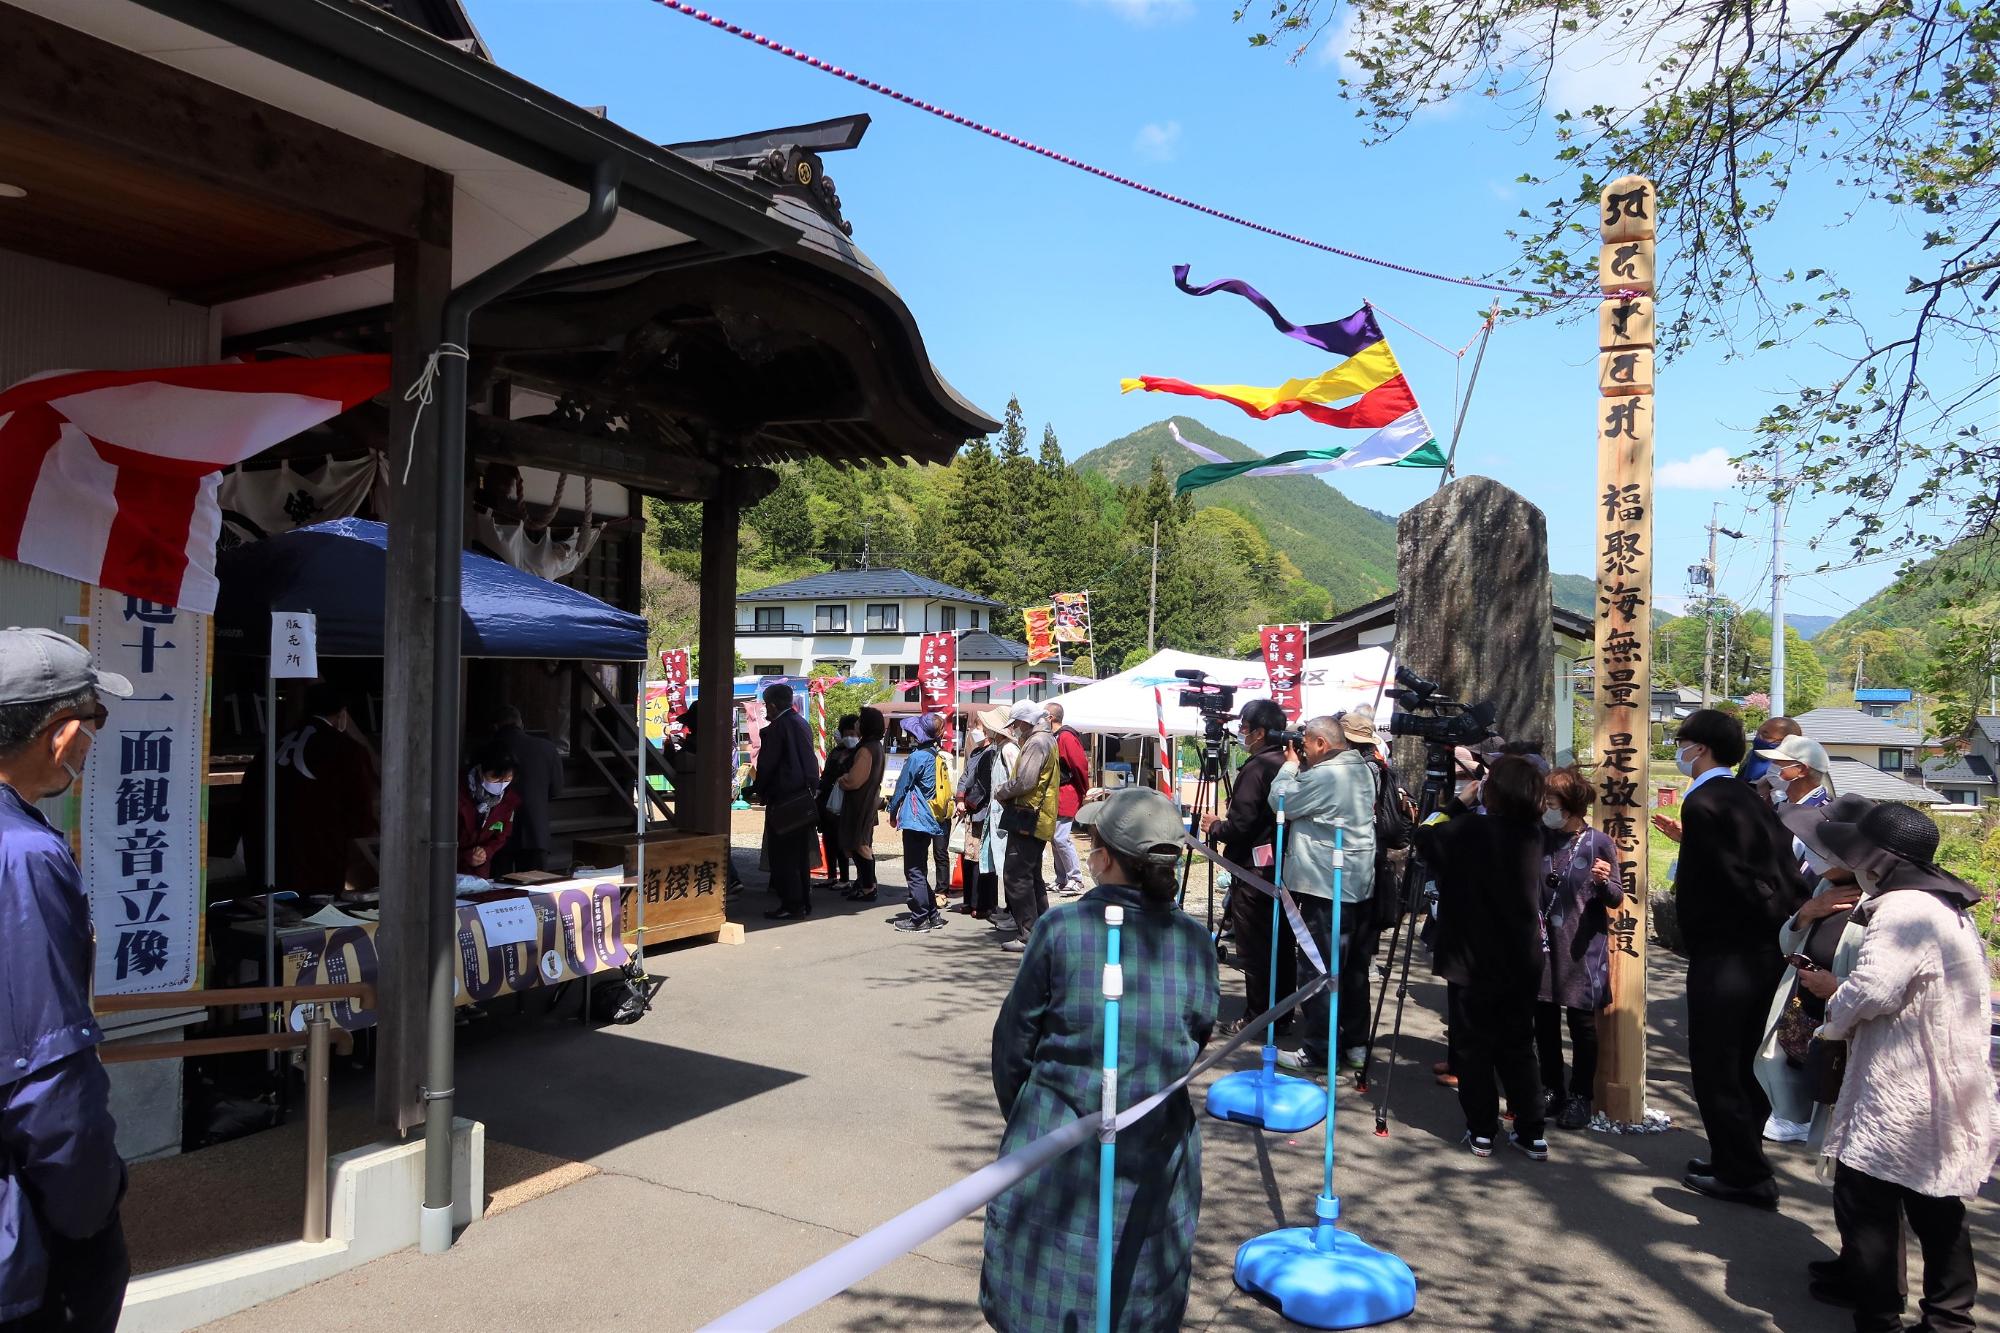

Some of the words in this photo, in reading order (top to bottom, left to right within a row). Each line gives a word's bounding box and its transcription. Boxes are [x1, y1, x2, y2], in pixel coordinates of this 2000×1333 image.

[285, 619, 302, 667] 販売所
[1269, 633, 1280, 662] 文化財
[1271, 664, 1296, 723] 木造十一
[1662, 797, 1668, 806] 6
